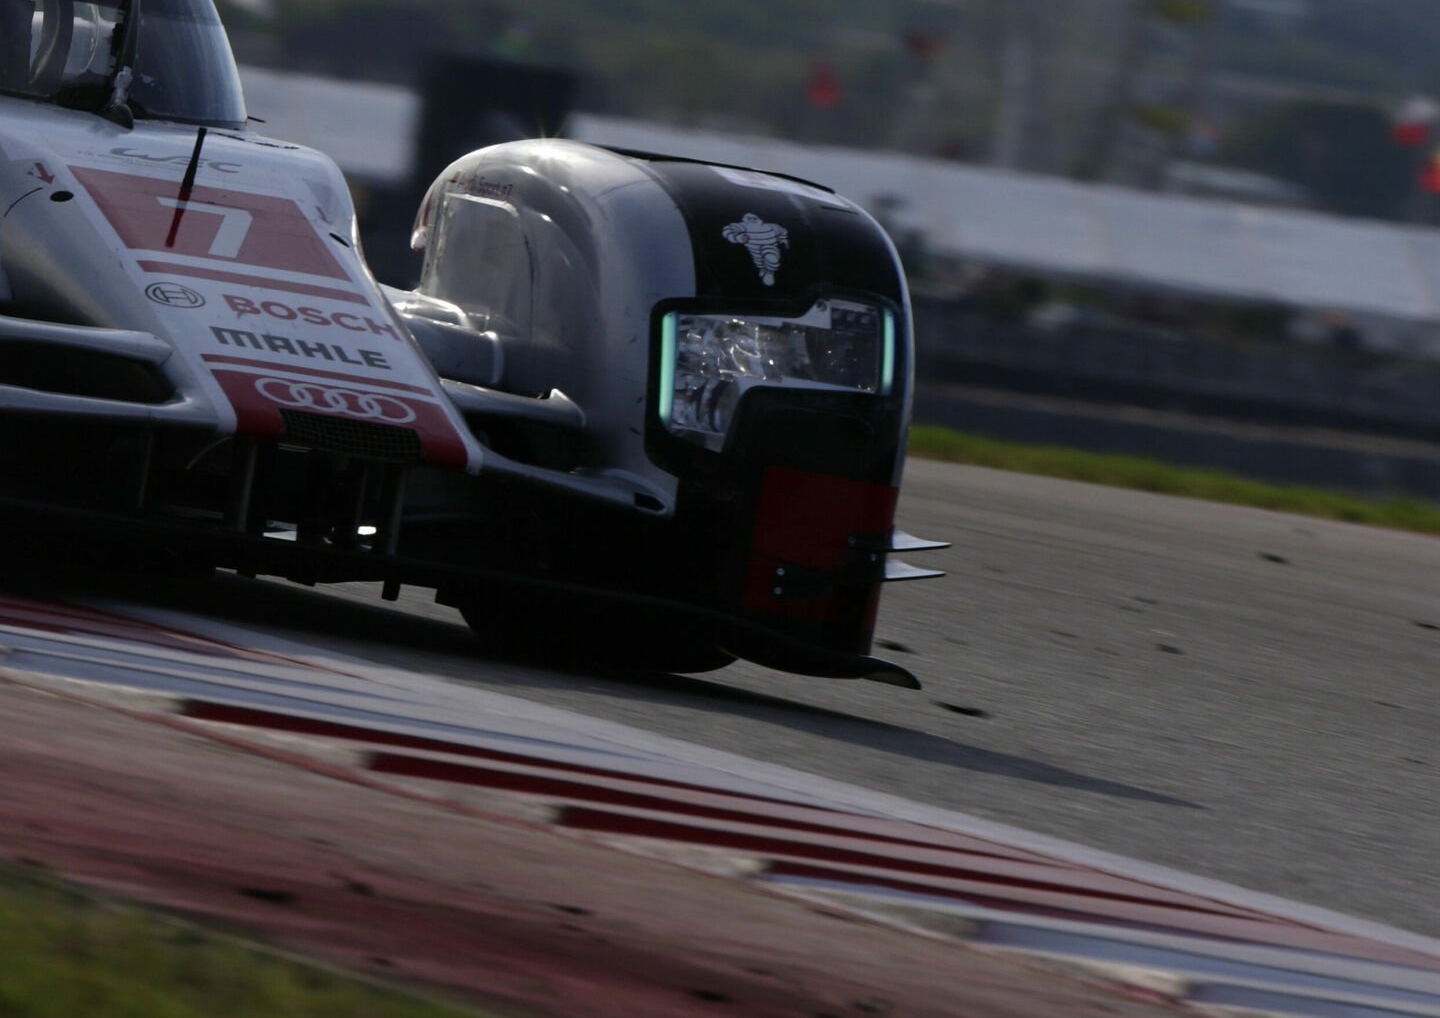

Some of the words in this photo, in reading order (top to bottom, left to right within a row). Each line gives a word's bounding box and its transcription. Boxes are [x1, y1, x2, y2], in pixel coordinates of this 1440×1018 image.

[157, 196, 253, 259] 7
[222, 293, 401, 343] BOSCH
[210, 325, 392, 371] MAHLE
